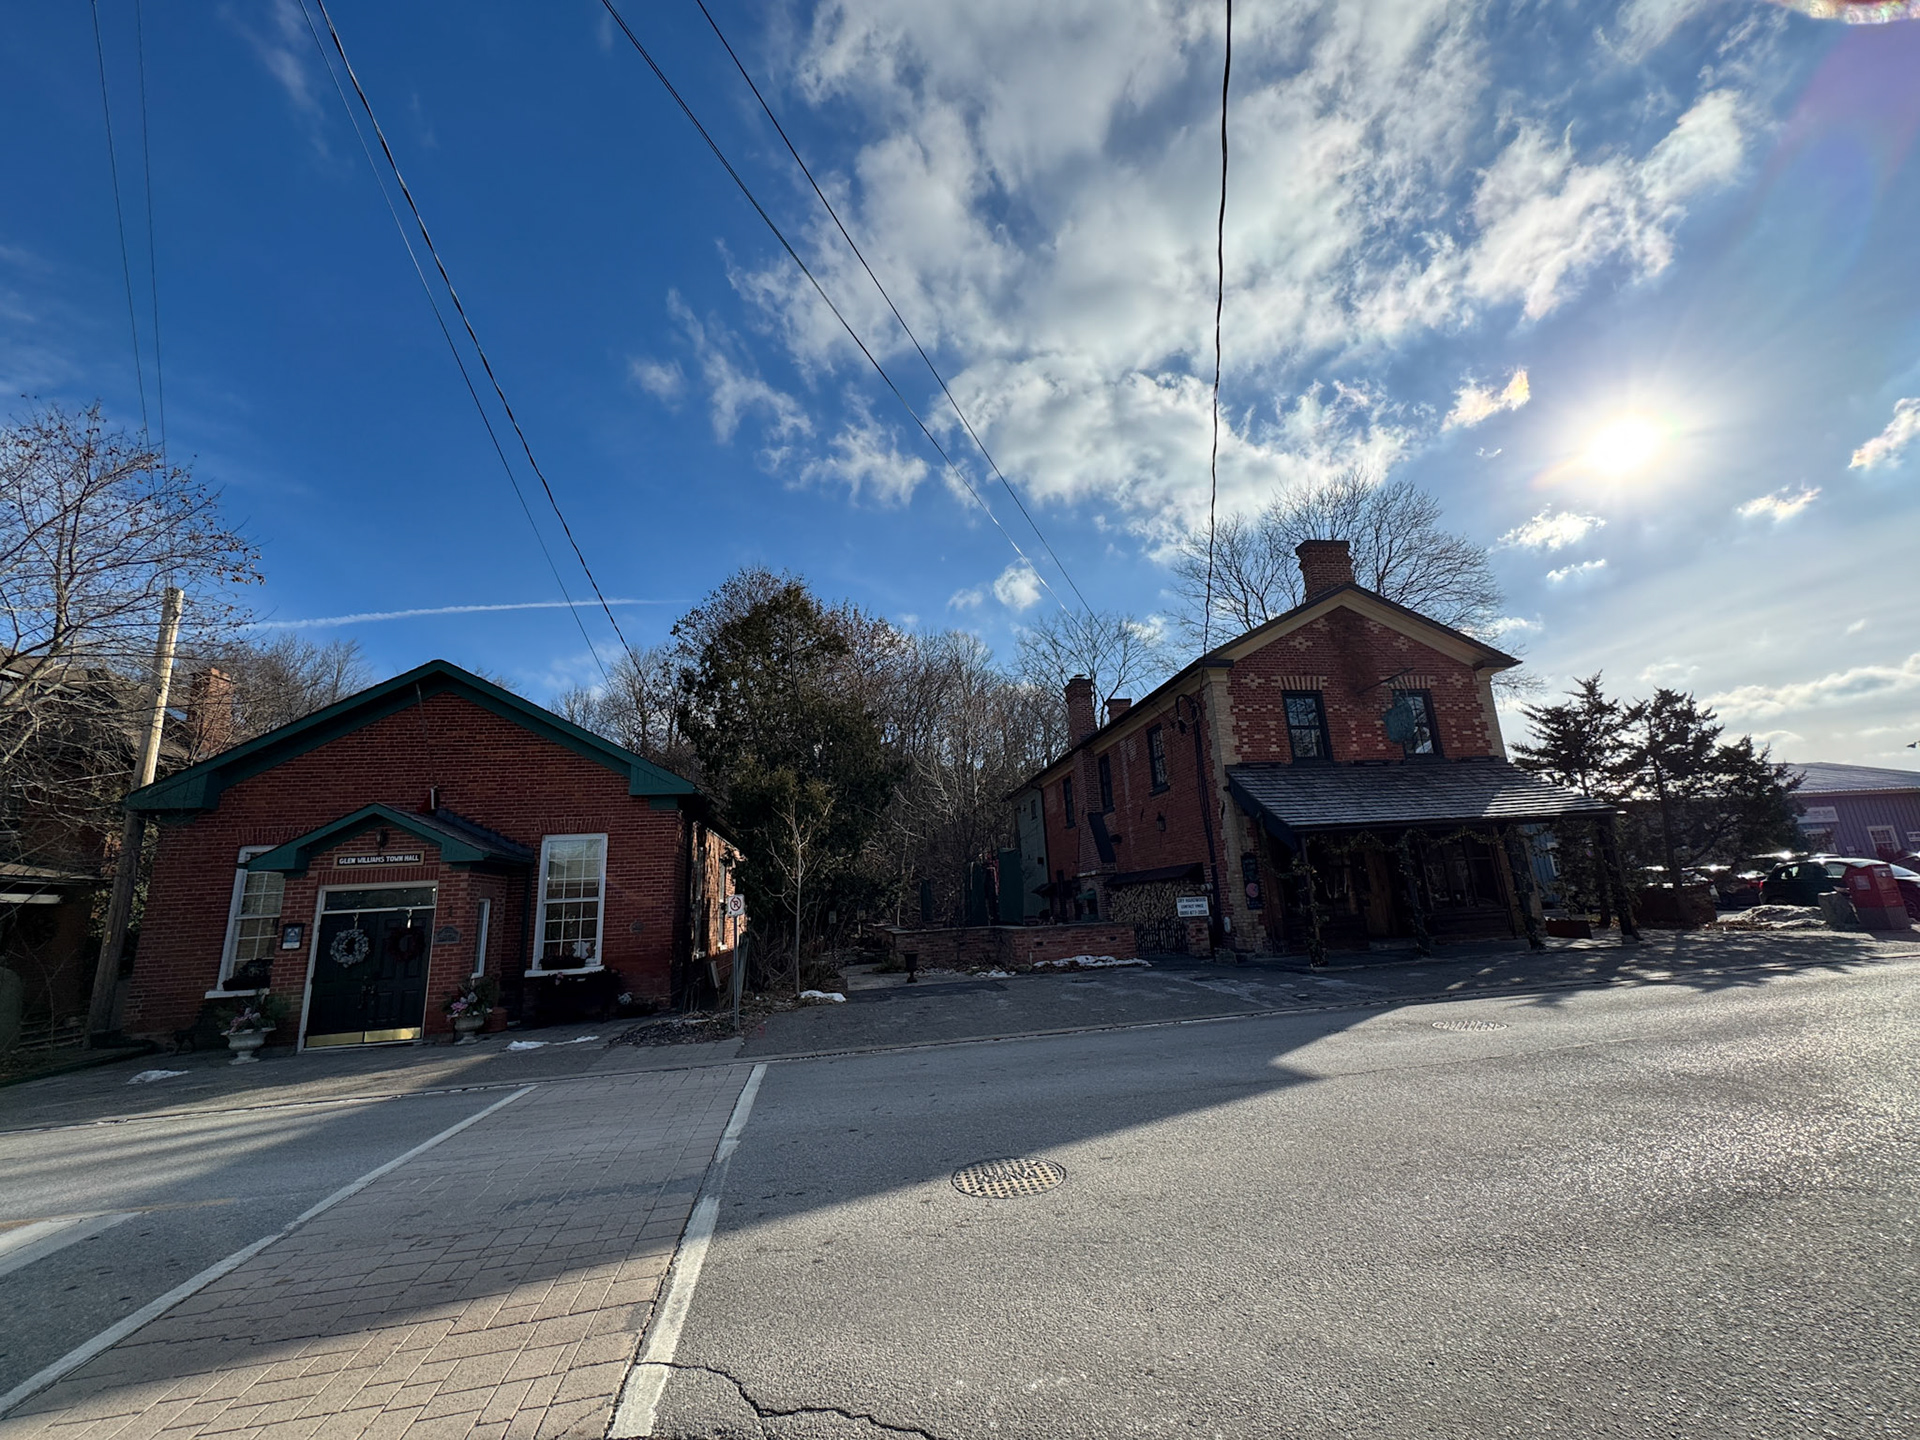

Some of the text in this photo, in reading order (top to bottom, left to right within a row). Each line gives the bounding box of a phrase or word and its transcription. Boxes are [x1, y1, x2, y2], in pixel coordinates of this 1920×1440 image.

[339, 854, 419, 865] GLEN WILLIAMS TOWN HALL
